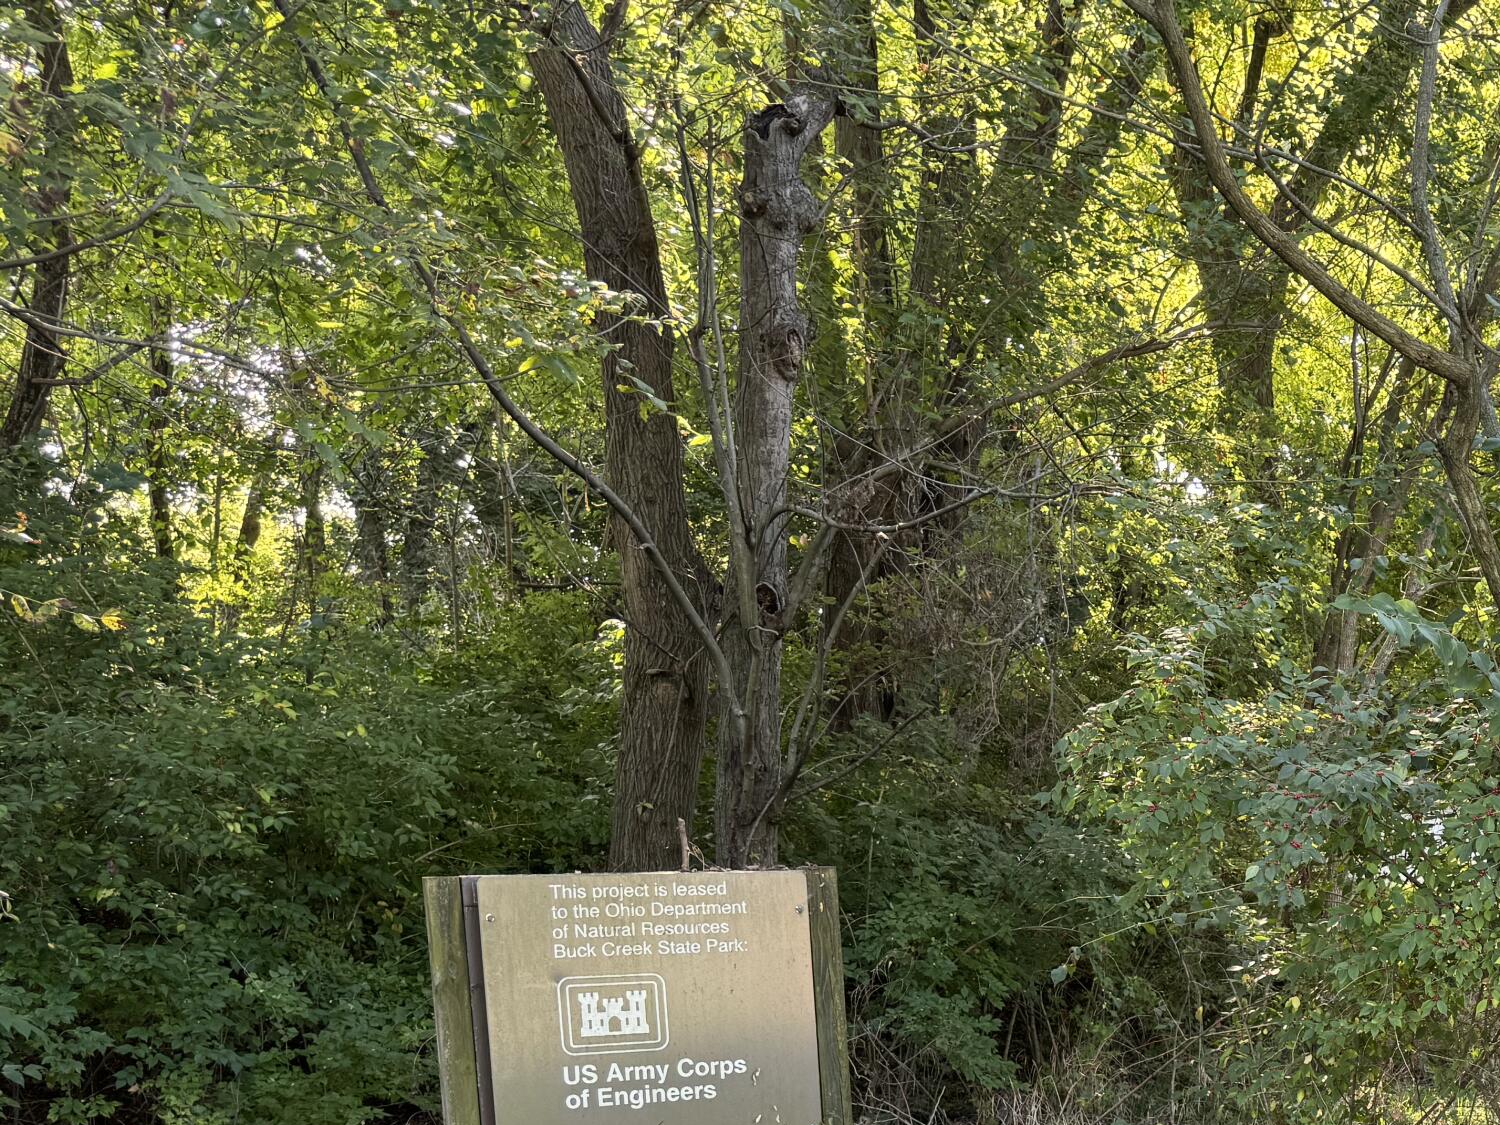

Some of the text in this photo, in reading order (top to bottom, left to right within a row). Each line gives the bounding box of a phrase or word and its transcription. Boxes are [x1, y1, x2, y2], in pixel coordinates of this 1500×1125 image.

[549, 881, 727, 902] This project is leased
[552, 900, 747, 919] to the Ohio Department
[552, 921, 730, 939] of Natural Resources
[554, 943, 597, 959] Buck
[601, 941, 652, 957] Creek
[657, 940, 701, 955] State
[563, 1057, 747, 1085] US Army Corps
[565, 1084, 717, 1109] of Engineers
